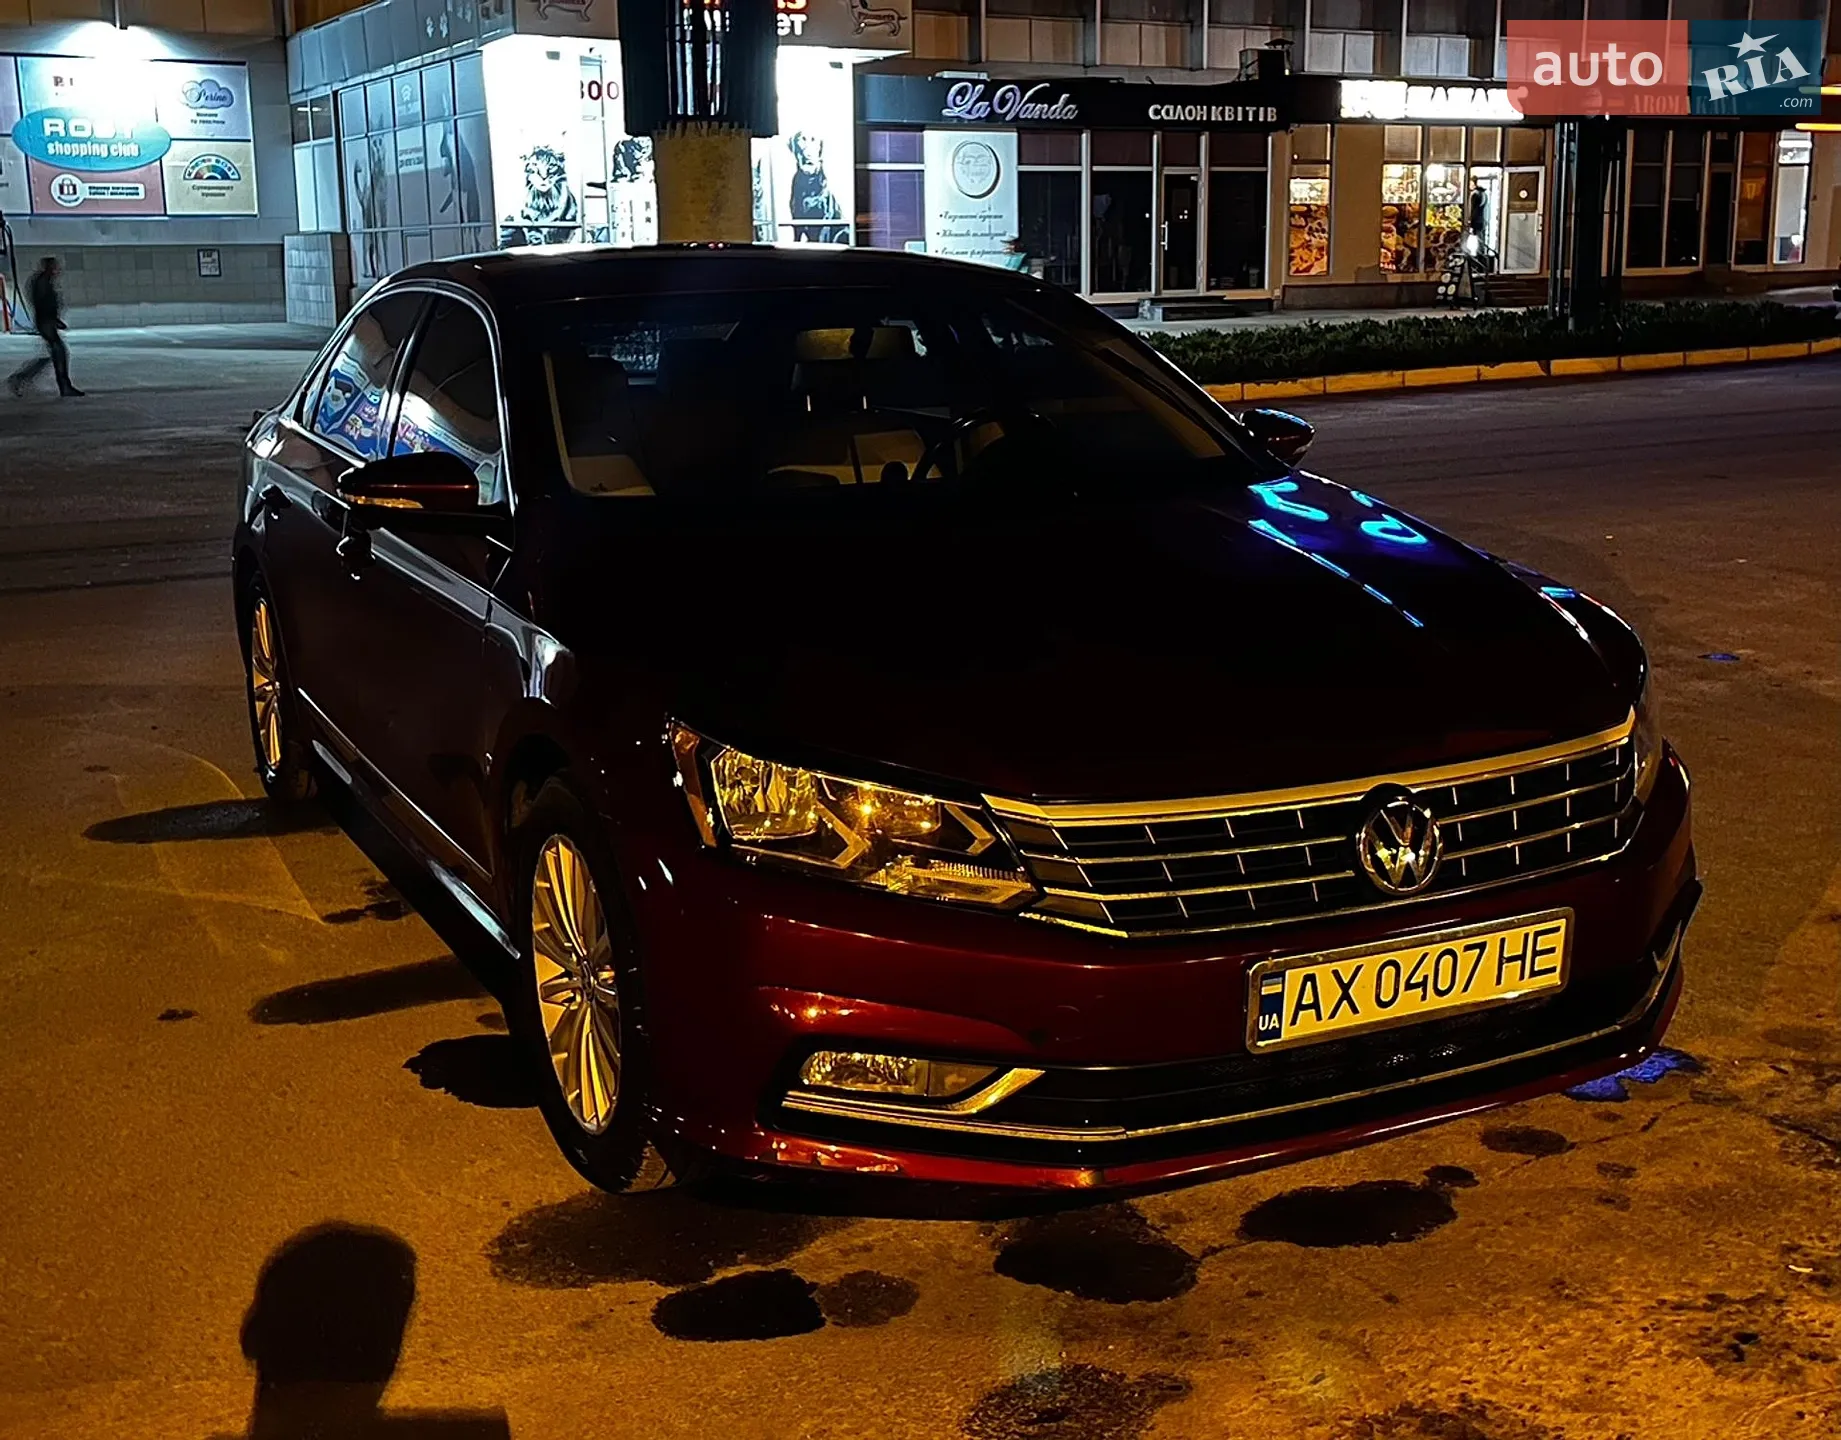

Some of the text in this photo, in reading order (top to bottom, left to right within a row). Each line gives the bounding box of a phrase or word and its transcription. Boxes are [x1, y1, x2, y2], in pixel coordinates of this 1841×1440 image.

[942, 82, 1079, 120] La Vanda
[1211, 105, 1278, 123] КВІТІВ
[47, 141, 140, 158] shopping club
[1289, 926, 1562, 1027] AX 0407 HE
[1257, 1015, 1280, 1032] UA
